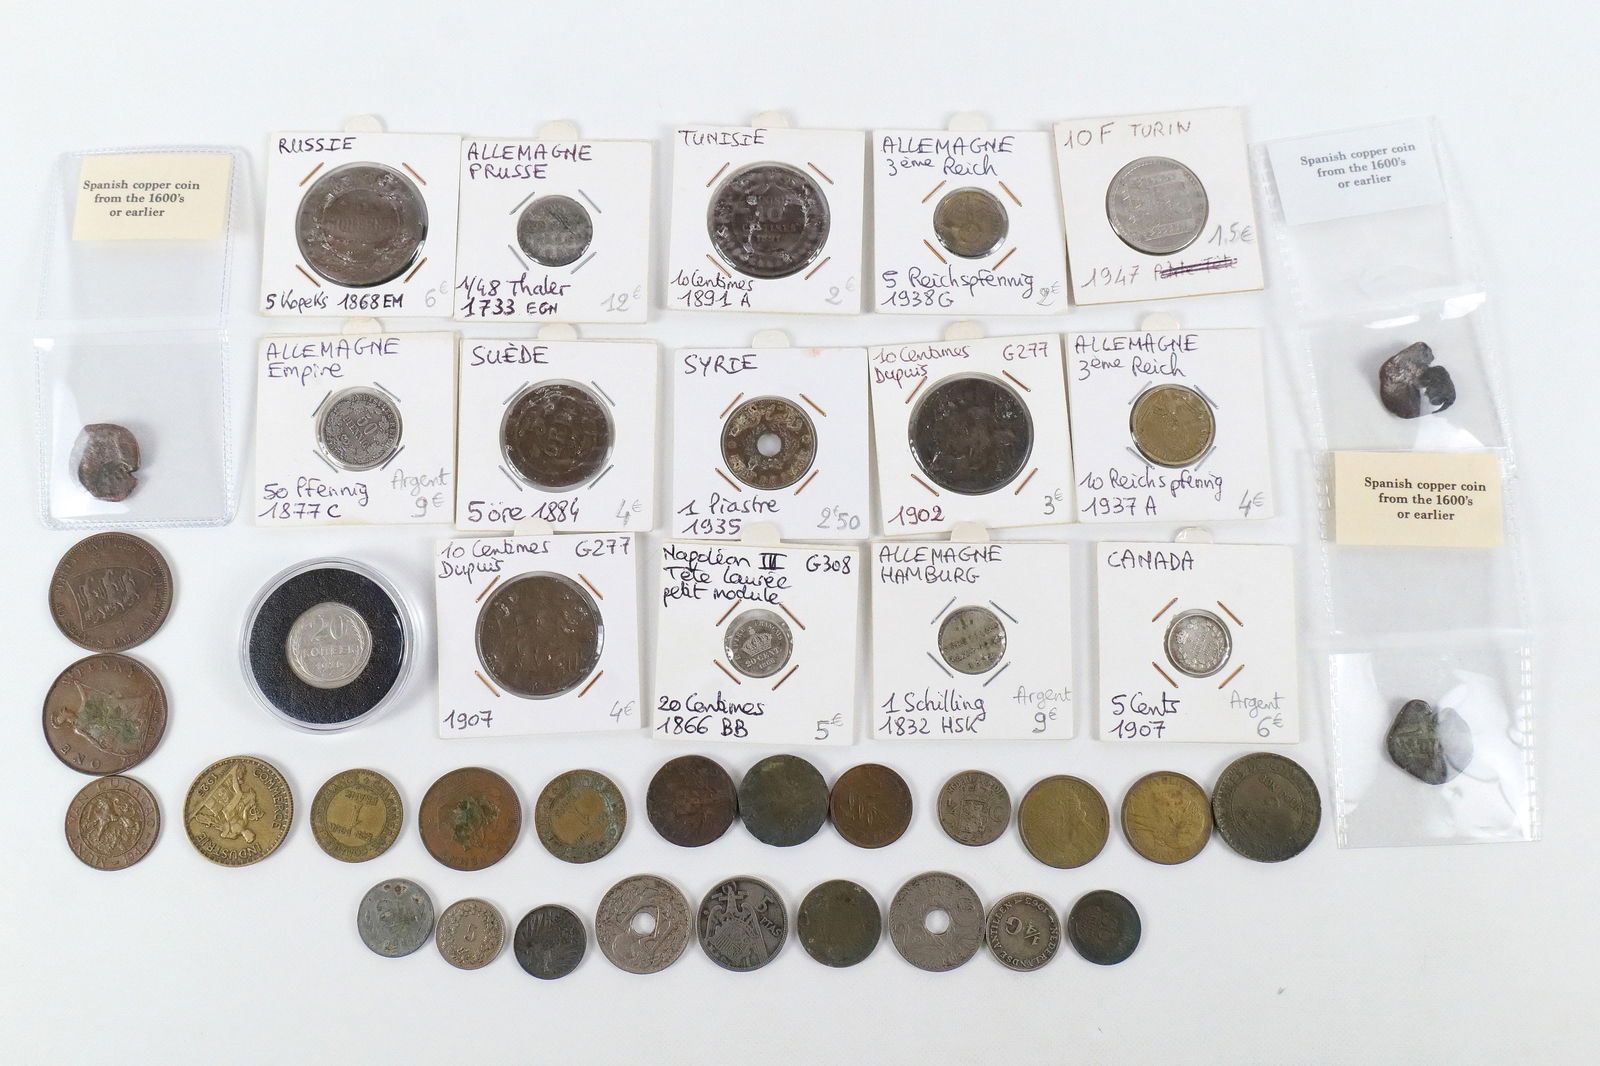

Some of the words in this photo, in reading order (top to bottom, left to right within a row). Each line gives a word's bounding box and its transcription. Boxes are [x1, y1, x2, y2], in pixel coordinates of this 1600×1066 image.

[678, 129, 767, 146] TUNISIE
[1131, 121, 1191, 137] TURIN
[279, 137, 356, 153] RUSSIE
[467, 142, 592, 162] ALLEMAGNE
[882, 136, 1015, 156] ALLEMAGNE
[1300, 151, 1347, 167] Spanish
[1351, 148, 1387, 159] copper
[1392, 143, 1416, 153] coin
[470, 163, 548, 179] PRUSSE
[887, 157, 935, 176] 3ème
[944, 154, 997, 176] Reich
[1317, 168, 1345, 177] from
[1349, 164, 1367, 173] the
[1372, 158, 1406, 170] 1600's
[83, 180, 128, 191] Spanish
[133, 182, 171, 191] copper
[175, 181, 200, 190] coin
[1354, 174, 1392, 187] earlier
[94, 194, 121, 203] from
[126, 194, 145, 203] the
[148, 194, 185, 203] 1600's
[110, 209, 122, 217] or
[126, 208, 165, 217] earlier
[456, 276, 500, 299] 1/48
[507, 273, 571, 297] Thaler
[882, 271, 898, 288] 5
[909, 265, 1033, 299] Reichspfennig
[1081, 265, 1139, 287] 1947
[266, 294, 277, 309] 5
[461, 298, 515, 317] 1733
[677, 290, 732, 307] 1891
[741, 292, 750, 307] A
[266, 337, 400, 361] ALLEMAGNE
[471, 342, 549, 366] SUÈDE
[873, 348, 896, 364] 10
[900, 346, 970, 362] Centimes
[1003, 342, 1047, 360] G277
[1075, 333, 1199, 354] ALLEMAGNE
[268, 362, 344, 386] Empire
[684, 354, 757, 376] SYRIE
[1078, 356, 1125, 380] 3ème
[1132, 353, 1186, 377] Reich
[874, 364, 928, 388] Dupuis
[391, 468, 450, 496] Argent
[1080, 472, 1103, 490] 10
[1364, 477, 1412, 489] Spanish
[1417, 482, 1457, 492] copper
[1461, 481, 1486, 491] coin
[263, 484, 289, 500] 50
[297, 477, 368, 507] Pfennig
[1379, 493, 1408, 503] from
[1413, 494, 1432, 504] the
[1436, 495, 1473, 506] 1600's
[258, 502, 321, 519] 1877
[327, 504, 341, 518] C
[468, 501, 485, 522] 5
[532, 497, 579, 522] 1884
[677, 501, 699, 515] 1
[709, 493, 780, 514] Piastre
[1082, 498, 1137, 516] 1937
[1146, 496, 1157, 515] A
[888, 505, 945, 525] 1902
[1398, 511, 1410, 519] or
[1414, 510, 1455, 520] earlier
[682, 518, 742, 534] 1935
[440, 542, 465, 558] 10
[472, 539, 550, 557] Centimes
[575, 537, 630, 557] G277
[879, 545, 1002, 565] ALLEMAGNE
[663, 544, 751, 573] Napoléon
[759, 553, 787, 570] III
[806, 554, 851, 574] G308
[1108, 549, 1194, 571] CANADA
[439, 558, 504, 584] Dupuis
[881, 565, 979, 583] HAMBURG
[664, 582, 708, 607] petit
[714, 585, 780, 605] module
[310, 614, 344, 642] 20
[658, 696, 681, 712] 20
[686, 691, 764, 715] Centimes
[882, 692, 900, 714] 1
[905, 687, 986, 721] Schilling
[1013, 686, 1072, 709] Argent
[1111, 694, 1126, 715] 5
[1131, 692, 1180, 716] Cents
[1231, 690, 1285, 719] Argent
[443, 710, 493, 729] 1907
[657, 715, 712, 734] 1866
[721, 718, 748, 737] BB
[879, 716, 930, 735] 1832
[941, 716, 979, 733] HSK
[1109, 720, 1166, 738] 1907
[254, 768, 285, 829] COMMERCE
[198, 832, 262, 860] INDUSTRIE
[755, 896, 774, 912] 5
[760, 916, 782, 937] PTAS
